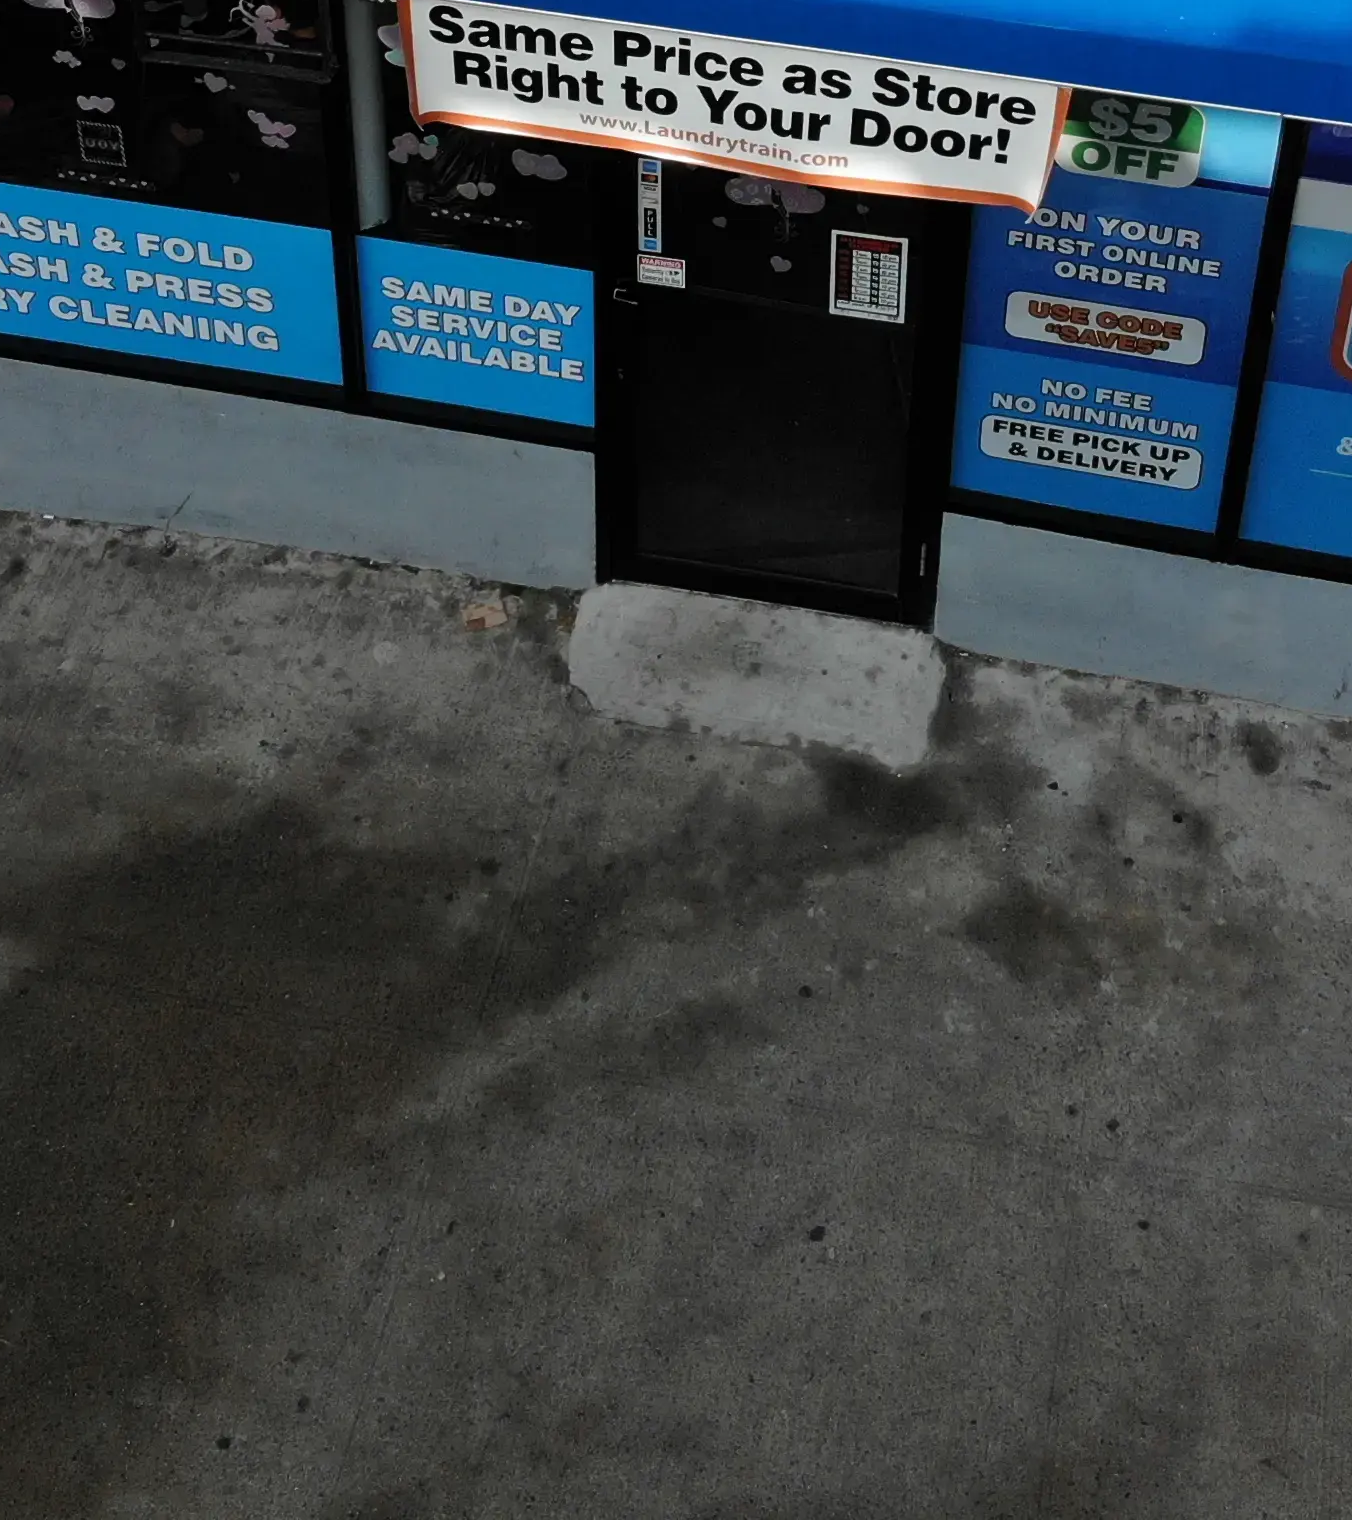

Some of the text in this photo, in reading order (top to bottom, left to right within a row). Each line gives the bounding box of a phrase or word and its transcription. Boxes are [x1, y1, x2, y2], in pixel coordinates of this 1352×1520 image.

[428, 3, 1037, 126] Same Price as Store
[451, 49, 1011, 165] Right to Your Door!
[1089, 97, 1174, 143] $5
[579, 111, 850, 170] www.Laundrytrain.com
[1069, 140, 1180, 181] OFF
[92, 226, 125, 254] &
[135, 232, 254, 272] FOLD
[1032, 207, 1201, 250] ON YOUR
[1007, 230, 1221, 278] FIRST ONLINE
[1053, 262, 1167, 294] ORDER
[81, 261, 115, 290] &
[126, 268, 276, 313] PRESS
[379, 275, 583, 328] SAME DAY
[48, 295, 281, 352] CLEANING
[390, 303, 563, 352] SERVICE
[1028, 300, 1183, 340] USE CODE
[371, 327, 586, 382] AVAILABLE
[991, 392, 1199, 440] NO MINIMUM
[1041, 379, 1153, 412] NO FEE
[992, 419, 1191, 465] FREE PICK UP
[1008, 441, 1178, 482] & DELIVERY
